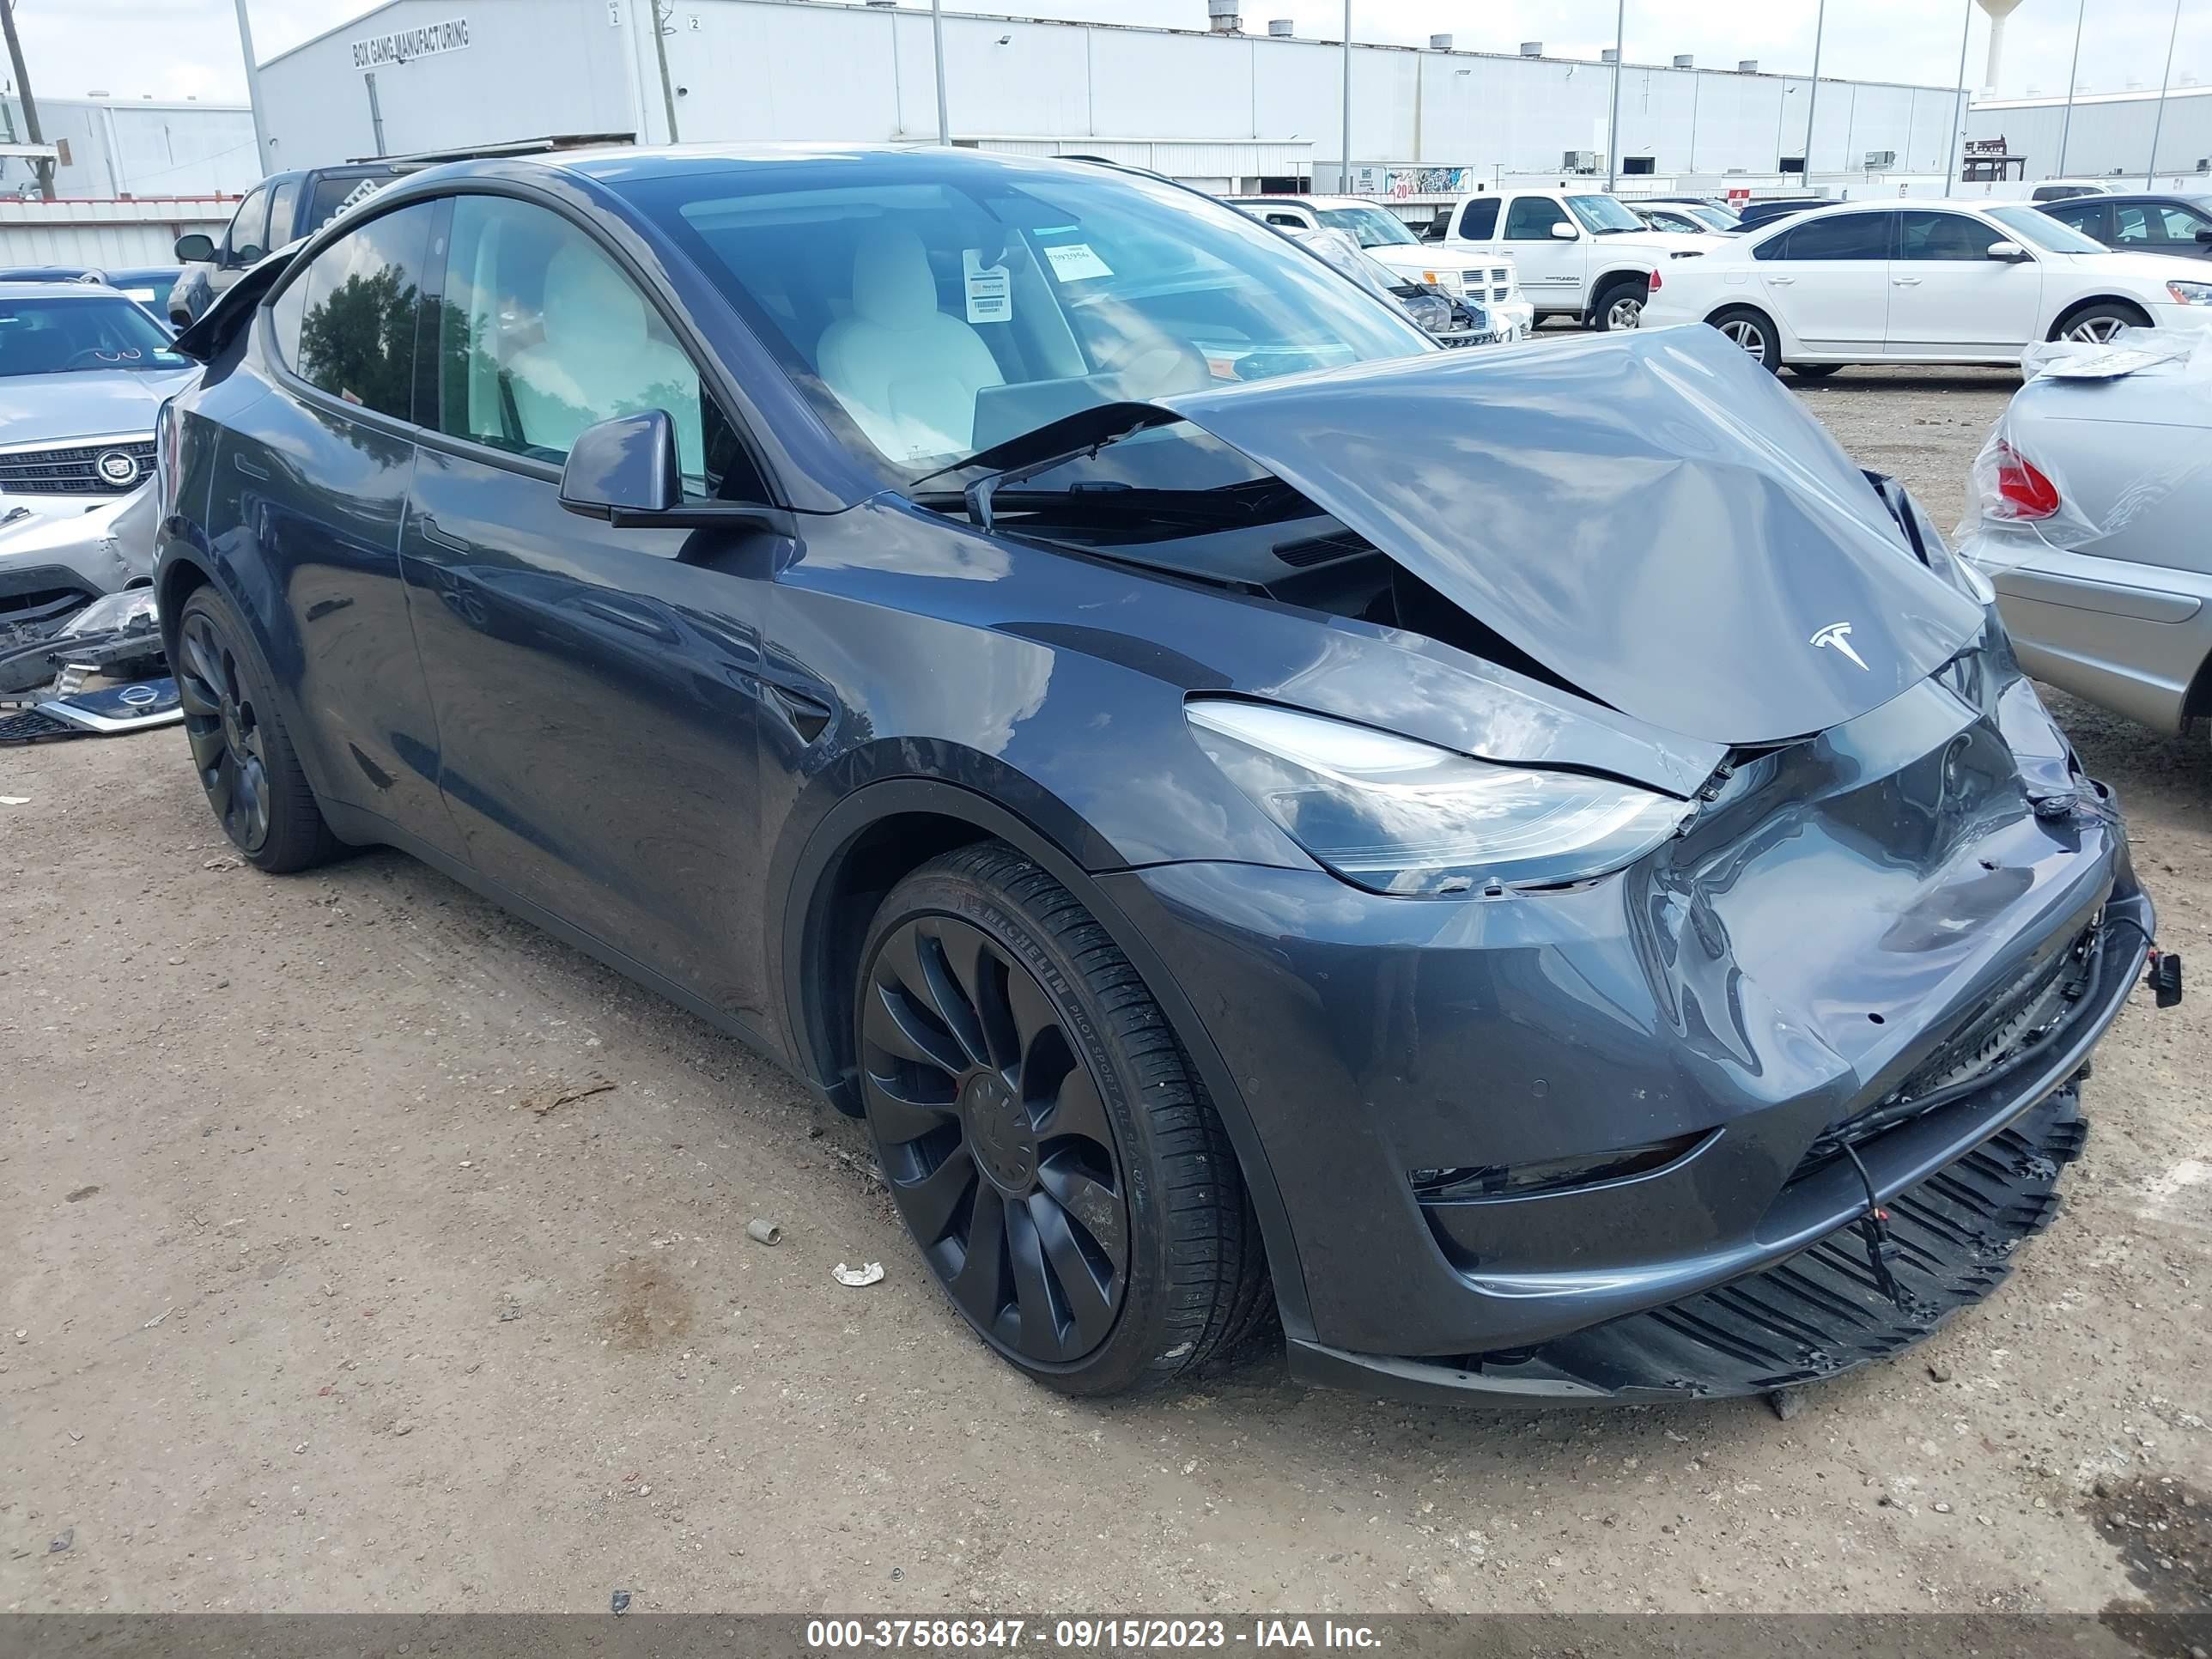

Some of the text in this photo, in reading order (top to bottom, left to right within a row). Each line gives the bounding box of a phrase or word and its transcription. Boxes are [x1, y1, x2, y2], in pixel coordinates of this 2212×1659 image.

[691, 19, 700, 29] 2
[352, 19, 469, 68] BOX GANG MANUFACTURING
[1396, 184, 1408, 199] 20
[982, 907, 1071, 995] MICHELIN
[1069, 1004, 1096, 1042] PILOT
[1091, 1044, 1119, 1094] SPORT
